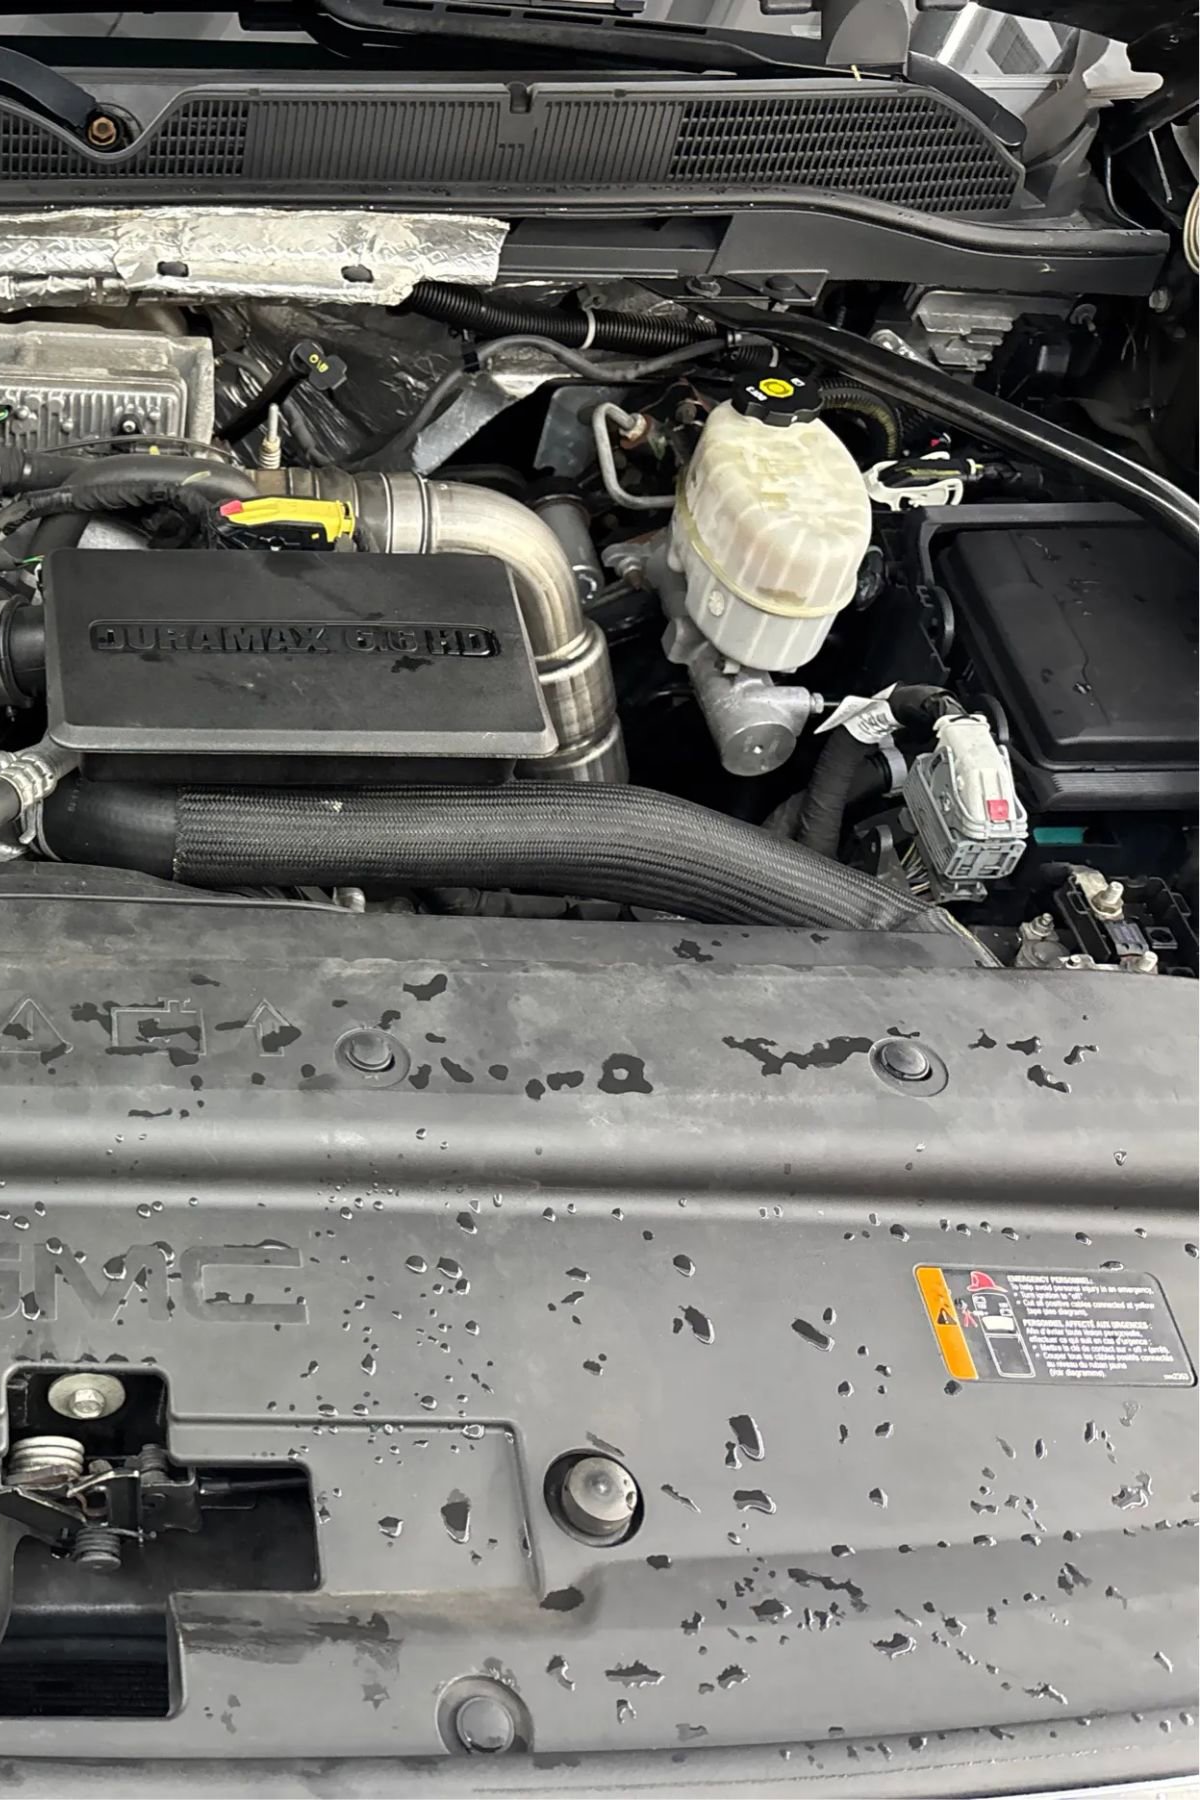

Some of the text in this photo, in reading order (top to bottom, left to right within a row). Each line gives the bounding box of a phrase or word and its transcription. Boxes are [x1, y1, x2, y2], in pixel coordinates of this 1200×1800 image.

[96, 625, 494, 657] DURAMAX 6.6 HD
